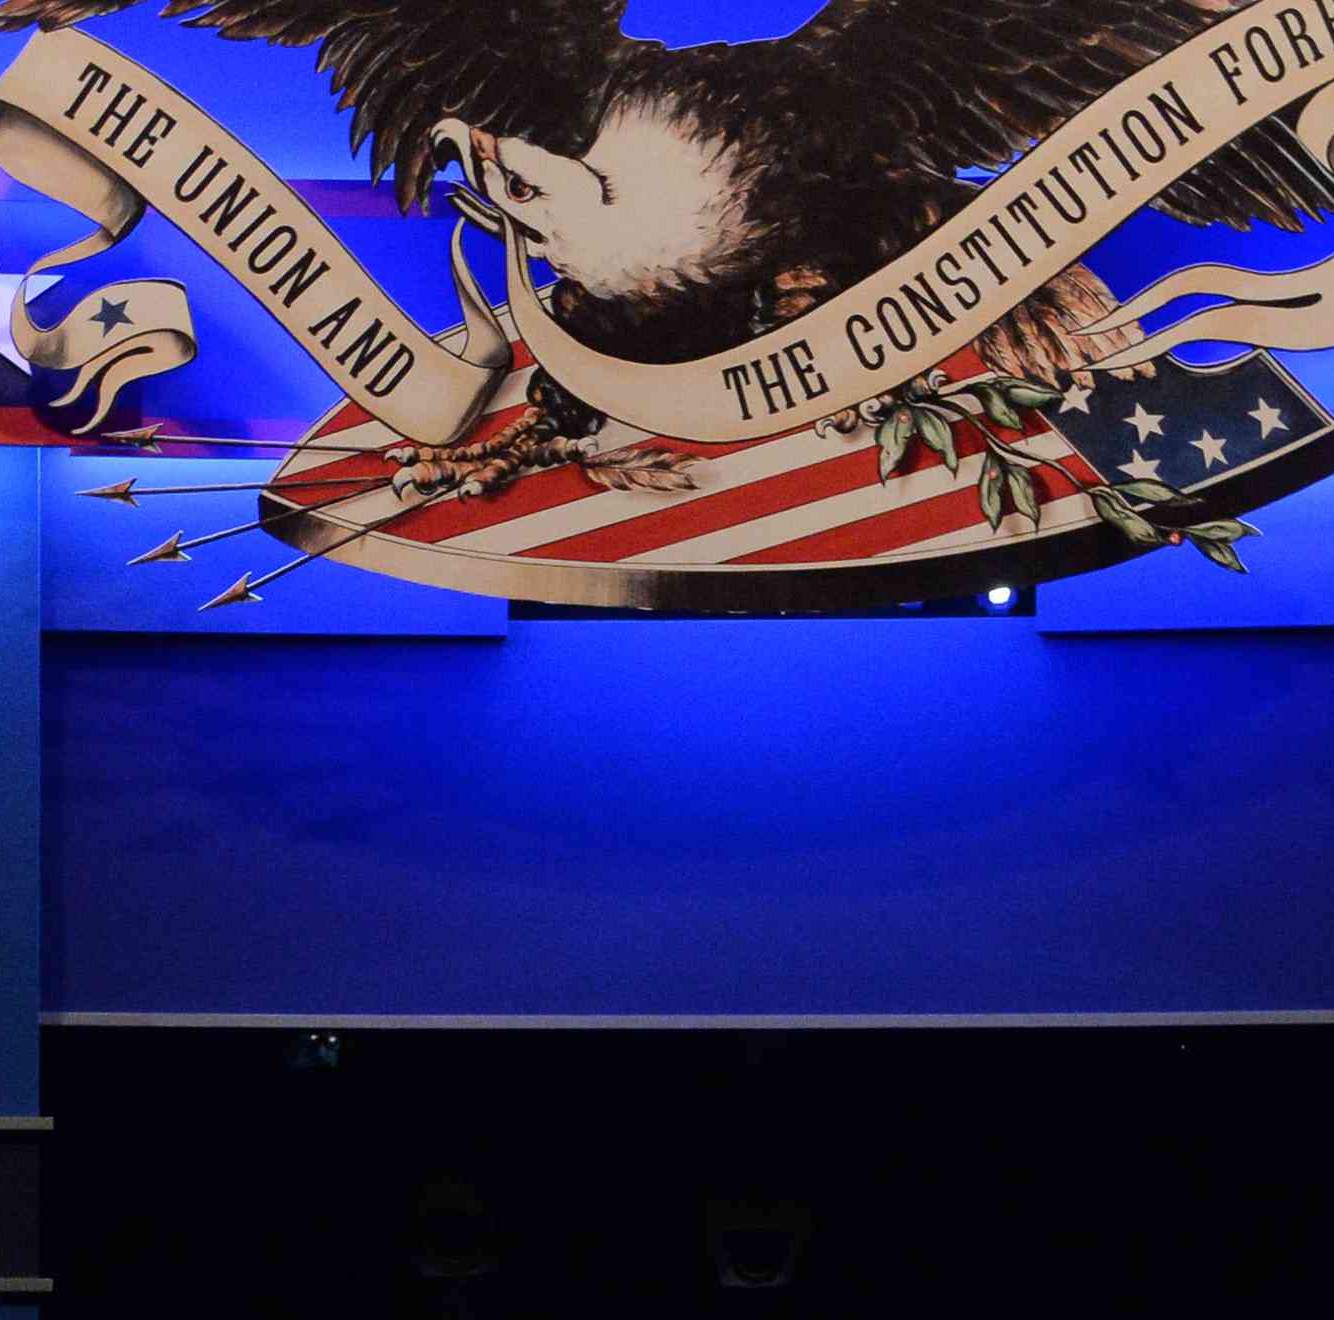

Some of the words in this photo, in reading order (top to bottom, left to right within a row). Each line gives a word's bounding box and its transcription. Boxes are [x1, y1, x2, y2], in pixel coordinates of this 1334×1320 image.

[63, 62, 176, 169] THE
[174, 145, 331, 308] UNION
[308, 297, 416, 397] AND
[722, 339, 829, 420] THE
[845, 81, 1205, 370] CONSTITUTION
